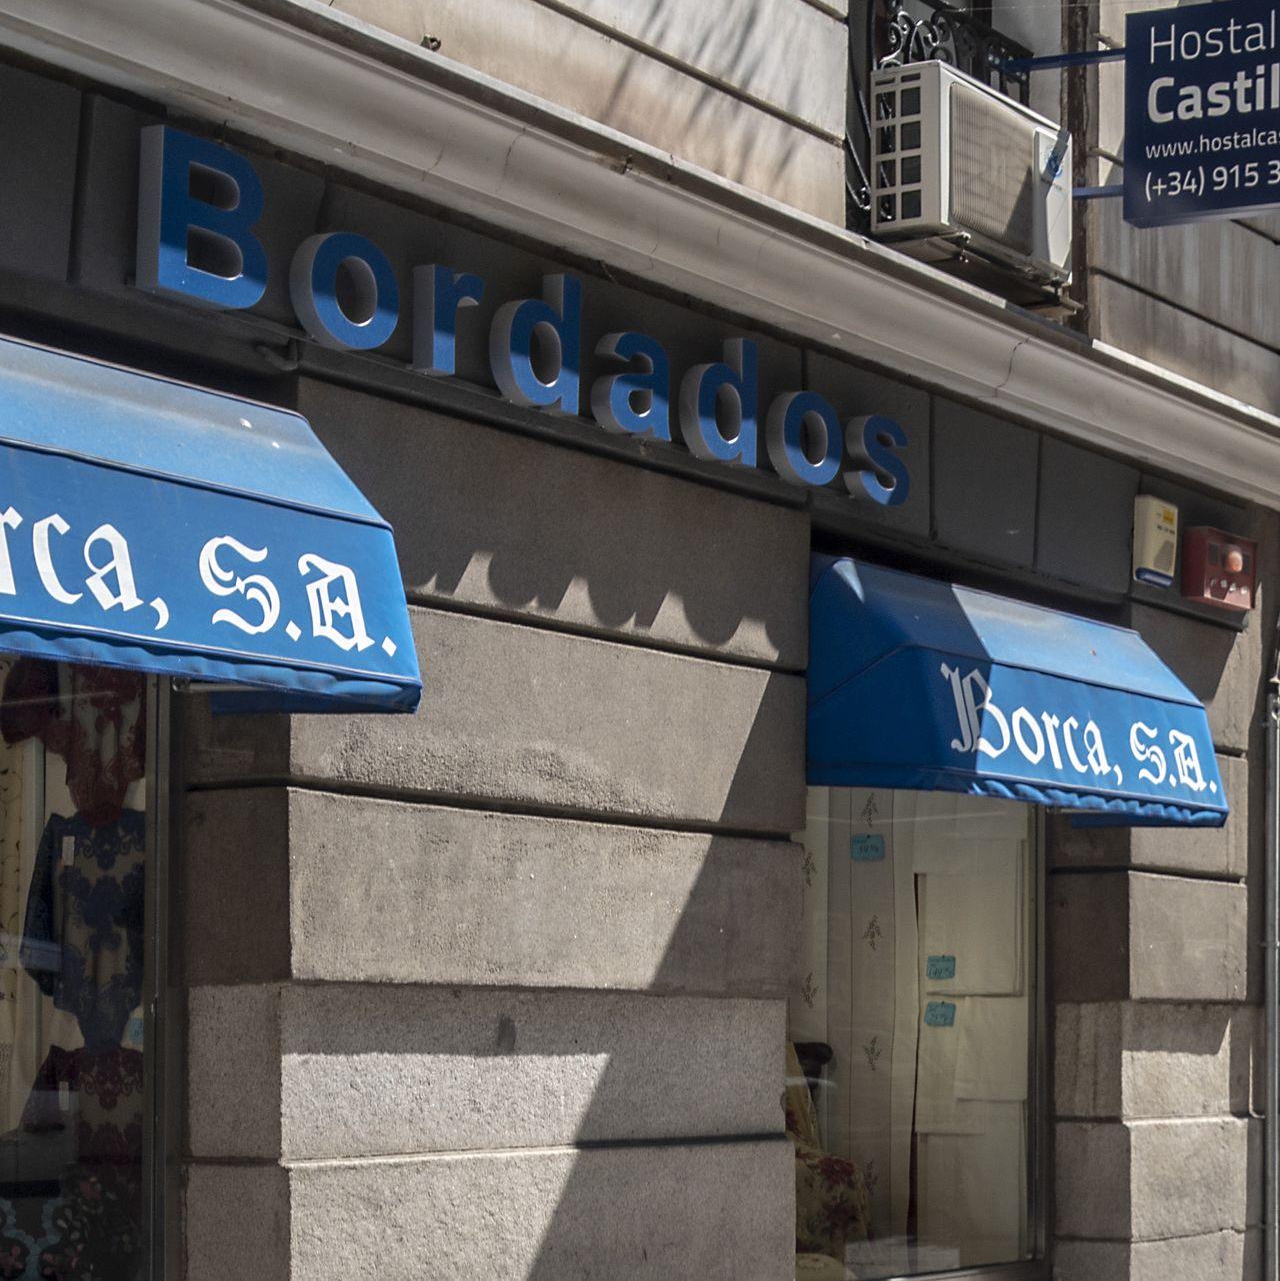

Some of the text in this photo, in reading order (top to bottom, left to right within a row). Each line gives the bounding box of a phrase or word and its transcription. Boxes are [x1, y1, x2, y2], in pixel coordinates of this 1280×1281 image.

[1149, 8, 1276, 64] Hostal
[1144, 166, 1205, 202] (+34)
[1212, 162, 1260, 192] 915
[137, 124, 911, 507] Bordados
[198, 535, 398, 657] S.A.
[940, 662, 1218, 794] Borca, S.A.
